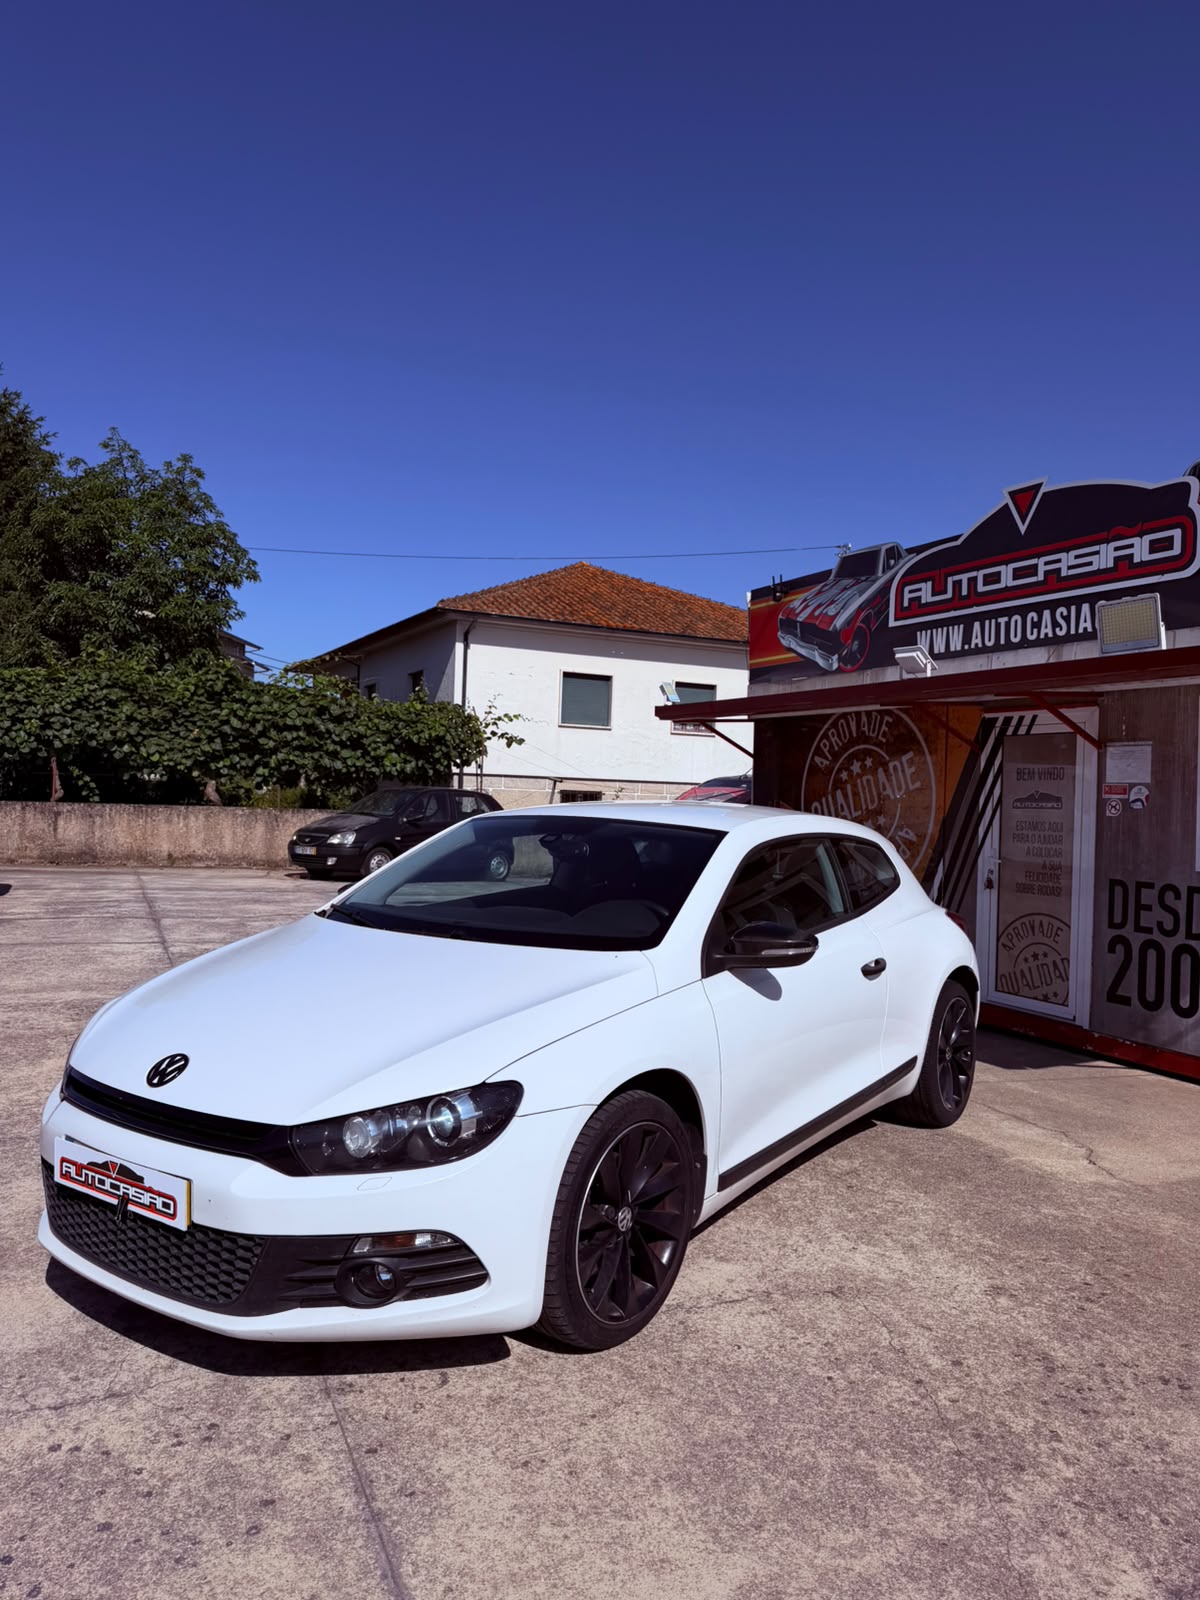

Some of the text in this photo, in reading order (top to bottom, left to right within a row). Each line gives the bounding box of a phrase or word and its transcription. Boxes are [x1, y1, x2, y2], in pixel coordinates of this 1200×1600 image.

[917, 603, 1098, 654] WWW.AUTOCASIA
[814, 711, 893, 768] APROVADE
[1016, 767, 1065, 781] BEM VINDO
[1016, 820, 1064, 833] ESTAMOS AQUI
[1012, 832, 1063, 846] PARA O AJUDAR
[1026, 846, 1063, 858] A COLOCAR
[1042, 860, 1063, 872] A SUA
[1024, 870, 1062, 885] FELICIDADE
[1016, 882, 1036, 895] SOBRE
[1001, 920, 1064, 952] APROVADE
[1106, 934, 1200, 1019] 200
